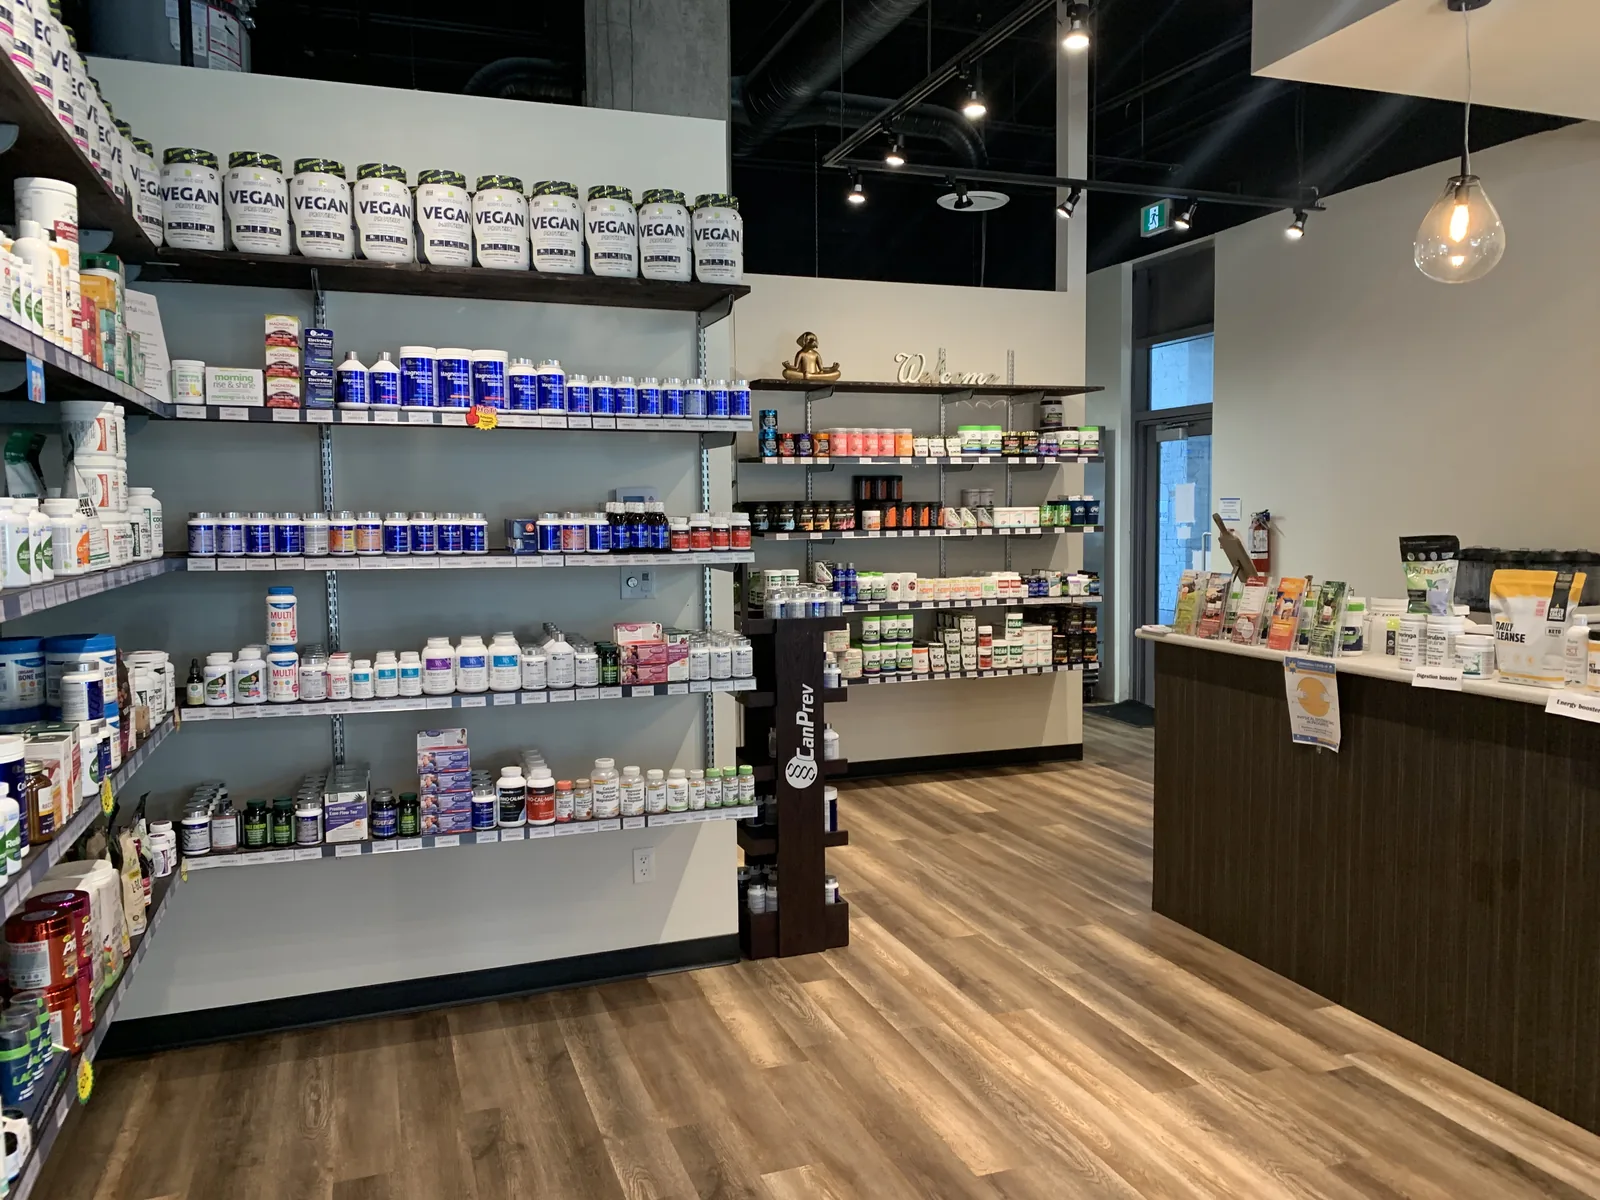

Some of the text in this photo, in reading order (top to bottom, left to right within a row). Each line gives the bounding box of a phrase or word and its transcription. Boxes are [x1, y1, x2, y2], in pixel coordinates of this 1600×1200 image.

[160, 187, 219, 206] VEGAN
[229, 190, 285, 209] VEGAN
[294, 196, 349, 215] VEGAN
[359, 201, 411, 219] VEGAN
[423, 206, 471, 224] VEGAN
[475, 211, 524, 227] VEGAN
[531, 216, 580, 232] VEGAN
[589, 220, 635, 236] VEGAN
[640, 223, 685, 238] VEGAN
[694, 227, 740, 243] VEGAN
[894, 352, 1000, 384] Welcome
[214, 374, 254, 383] morning
[228, 381, 234, 389] &
[270, 611, 291, 619] MULTI
[1439, 674, 1458, 682] booster
[1556, 699, 1600, 713] Energy booster
[796, 682, 816, 761] CanPrev
